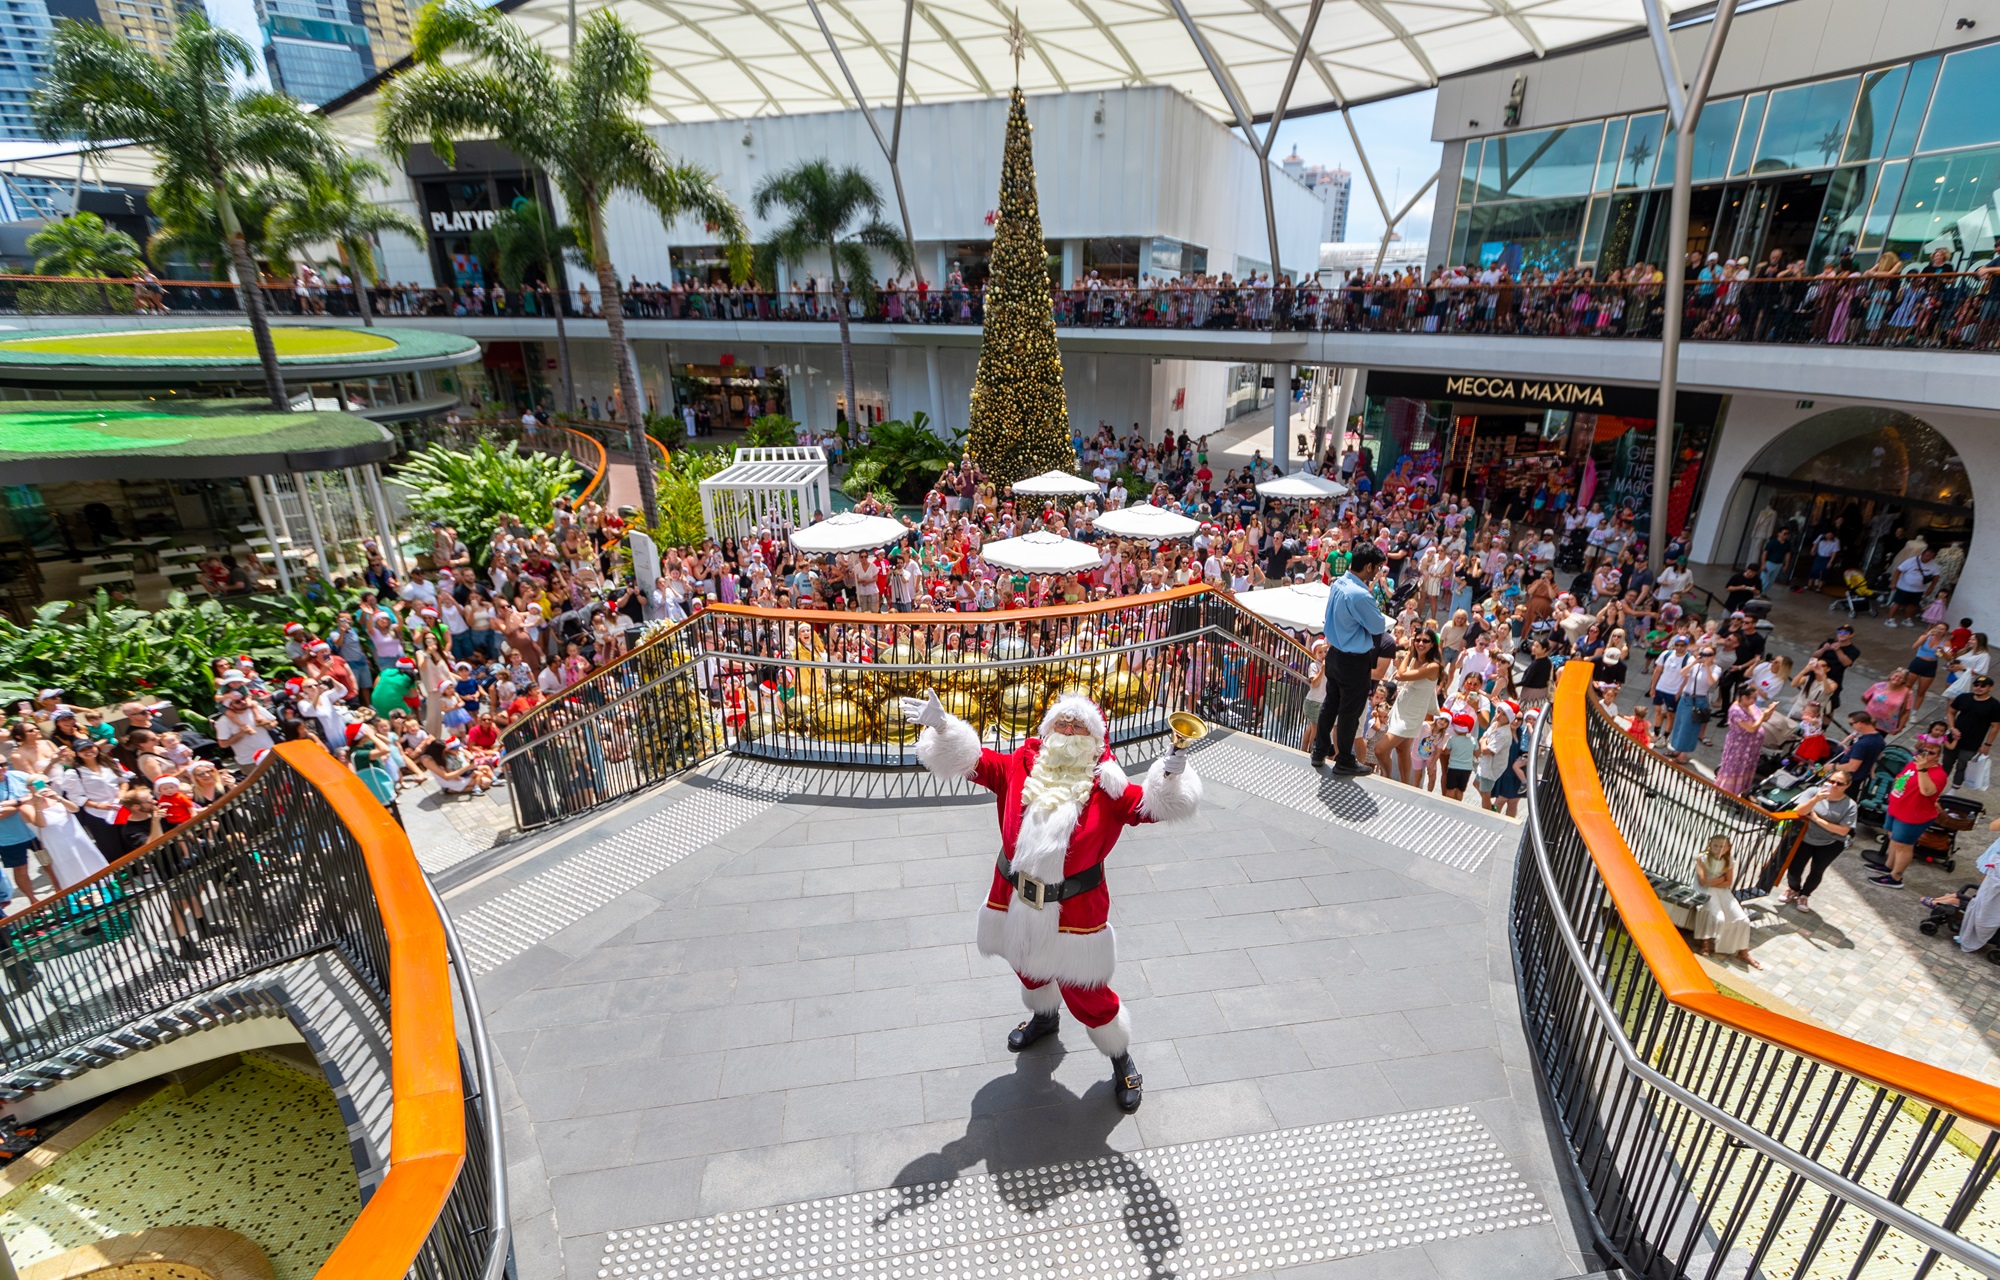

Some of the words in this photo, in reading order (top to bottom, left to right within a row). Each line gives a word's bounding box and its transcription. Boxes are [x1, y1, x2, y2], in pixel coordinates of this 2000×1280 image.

[1446, 377, 1515, 399] MECCA
[1520, 381, 1604, 407] MAXIMA
[1627, 445, 1655, 462] GIF
[1627, 461, 1654, 479] THE
[1614, 476, 1654, 497] MAGIC
[1622, 495, 1644, 511] OF
